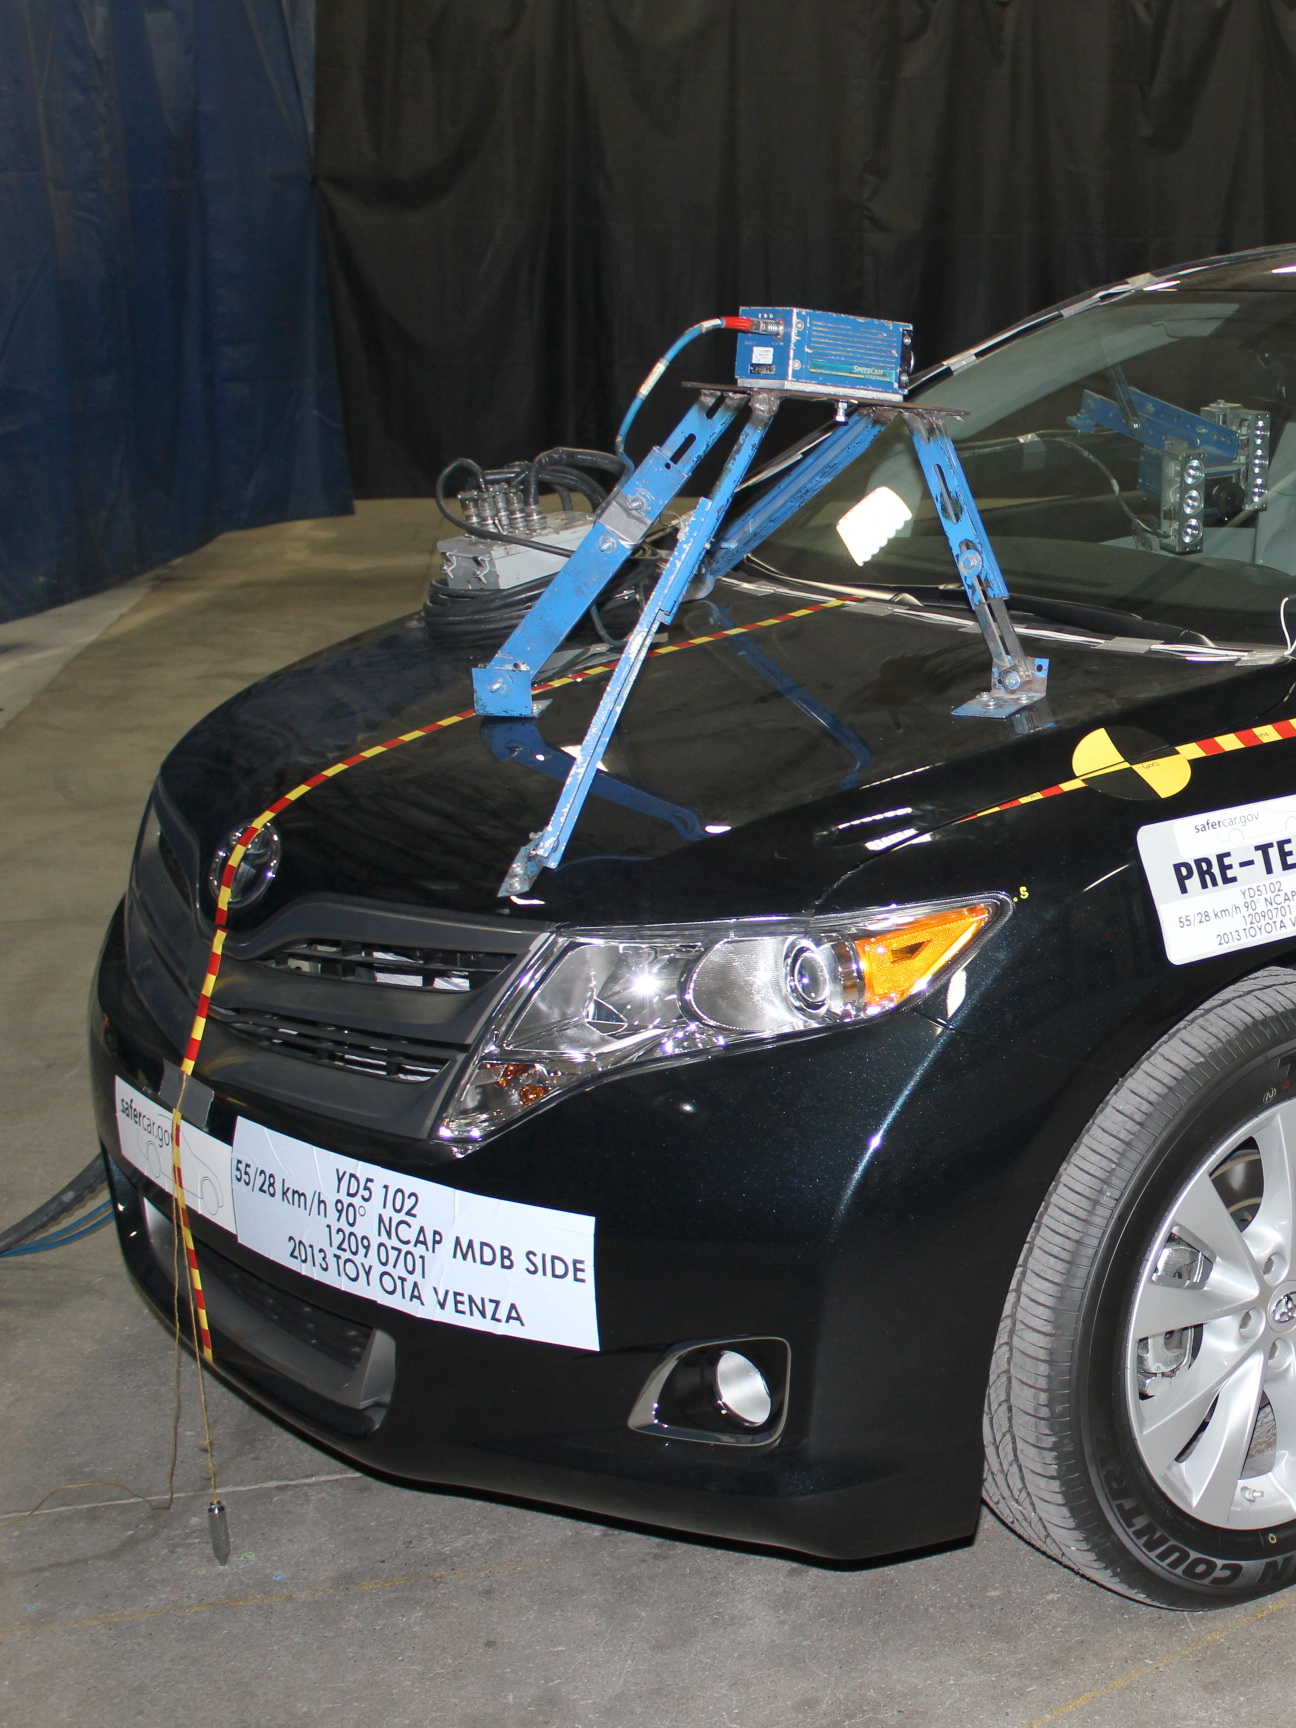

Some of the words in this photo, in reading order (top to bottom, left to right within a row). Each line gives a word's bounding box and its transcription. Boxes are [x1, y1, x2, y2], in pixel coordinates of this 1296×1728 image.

[1194, 811, 1260, 834] safercar.gov
[1239, 880, 1283, 900] YD5102
[1178, 909, 1211, 929] 55/28
[1213, 903, 1242, 923] km/h
[1264, 890, 1296, 909] NCAP
[1242, 904, 1293, 926] 12090701
[1216, 929, 1242, 946] 2013
[1242, 916, 1287, 939] TOYOTA
[234, 1158, 277, 1198] 55/28
[281, 1177, 329, 1219] km/h
[377, 1212, 444, 1255] NCAP
[453, 1235, 515, 1270] MDB
[525, 1249, 587, 1283] SIDE
[288, 1235, 330, 1272] 2013
[433, 1286, 526, 1328] VENZA
